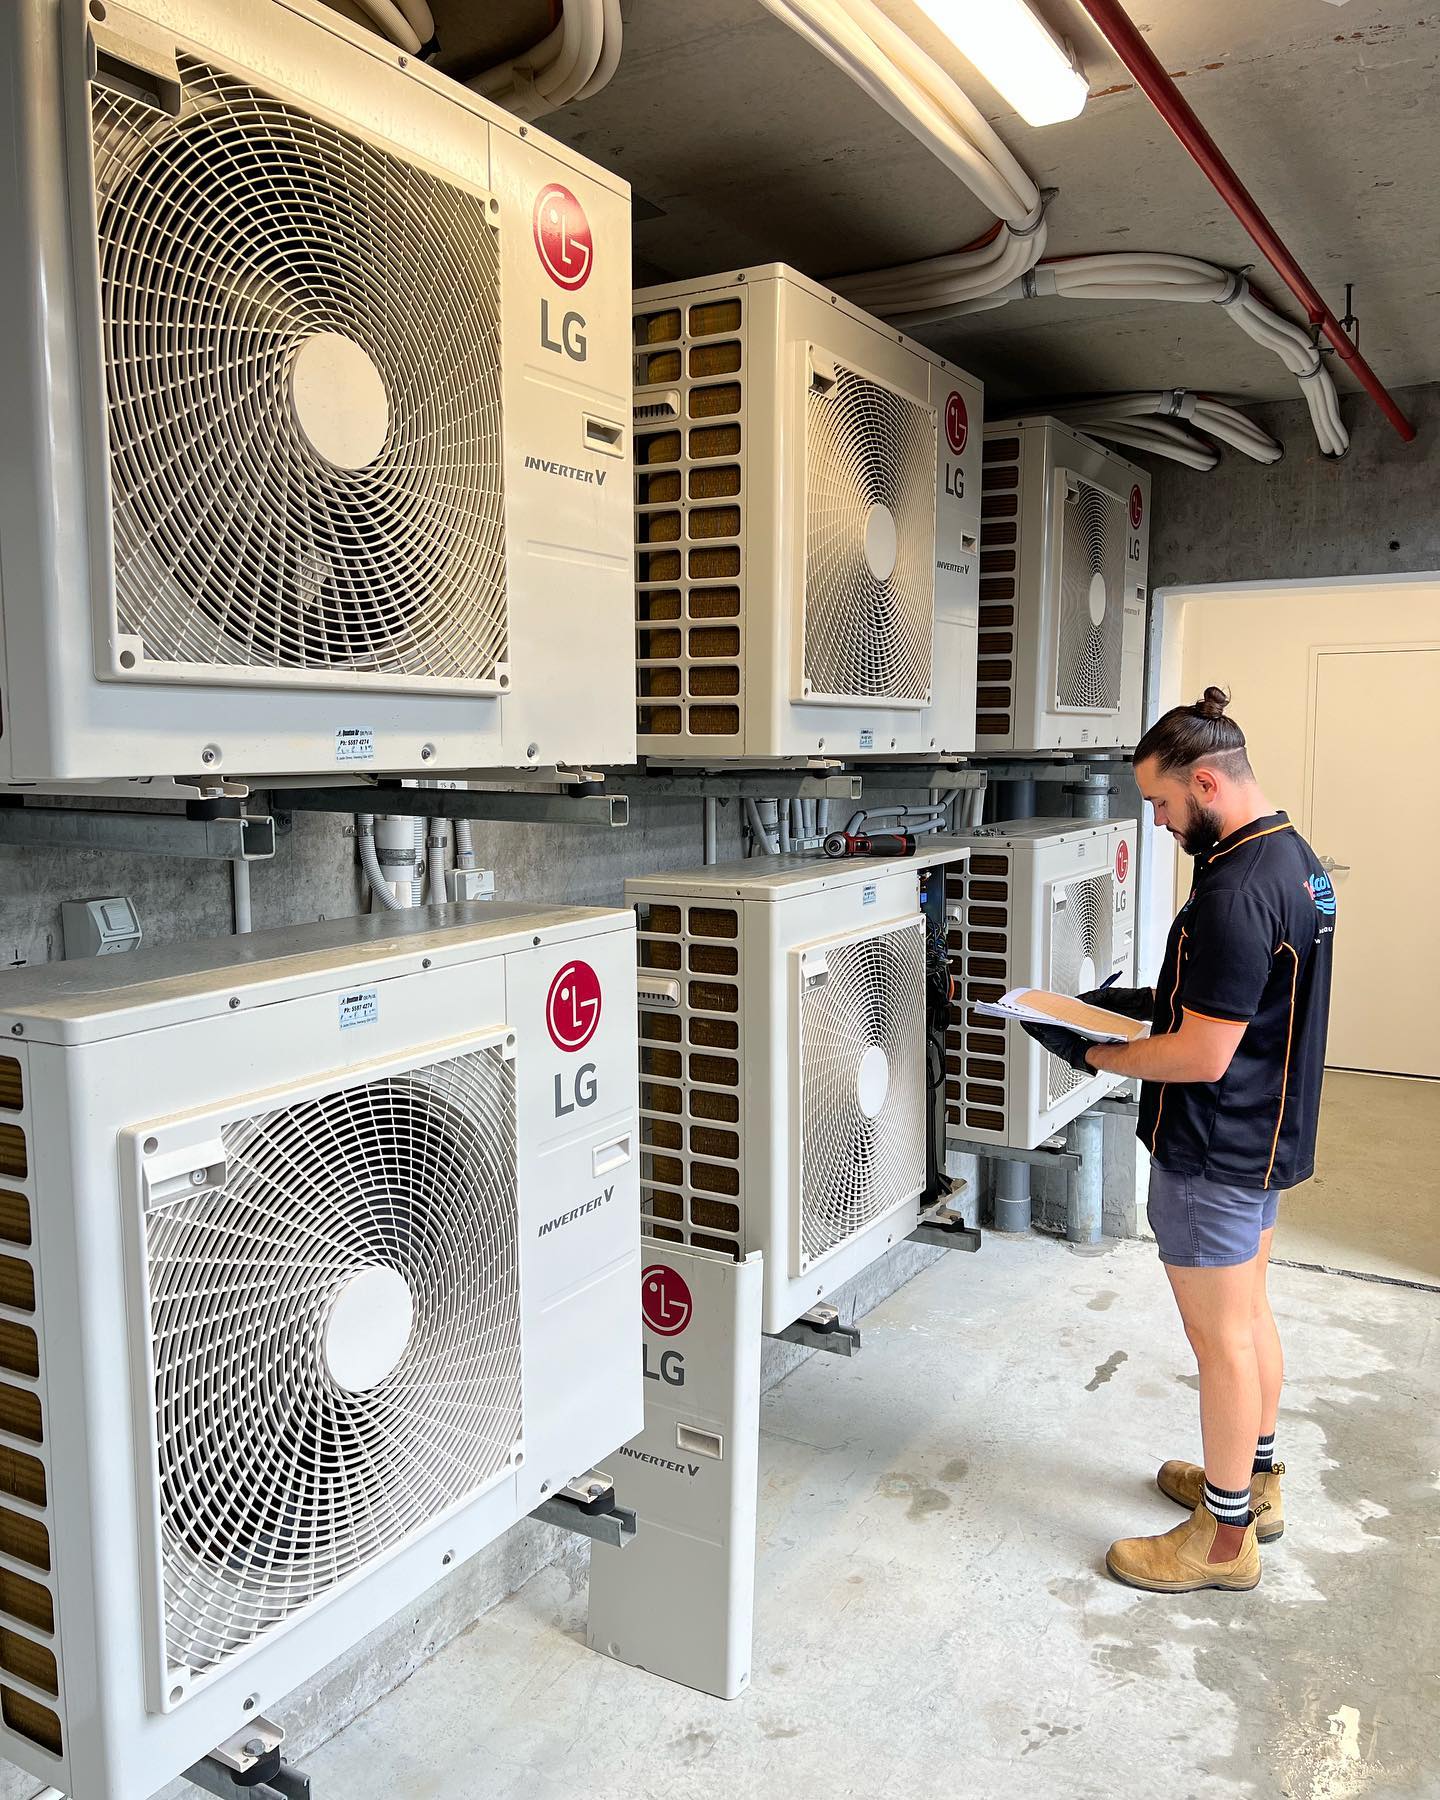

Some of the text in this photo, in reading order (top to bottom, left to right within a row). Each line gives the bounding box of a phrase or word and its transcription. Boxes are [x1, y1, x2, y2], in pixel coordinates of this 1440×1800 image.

[541, 298, 587, 362] LG
[524, 456, 593, 484] INVERTER
[945, 463, 965, 499] LG
[1129, 536, 1140, 561] LG
[1116, 890, 1127, 913] LG
[554, 1062, 598, 1118] LG
[538, 1196, 602, 1238] INVERTER
[642, 1343, 685, 1387] LG
[619, 1446, 685, 1475] INVERTER
